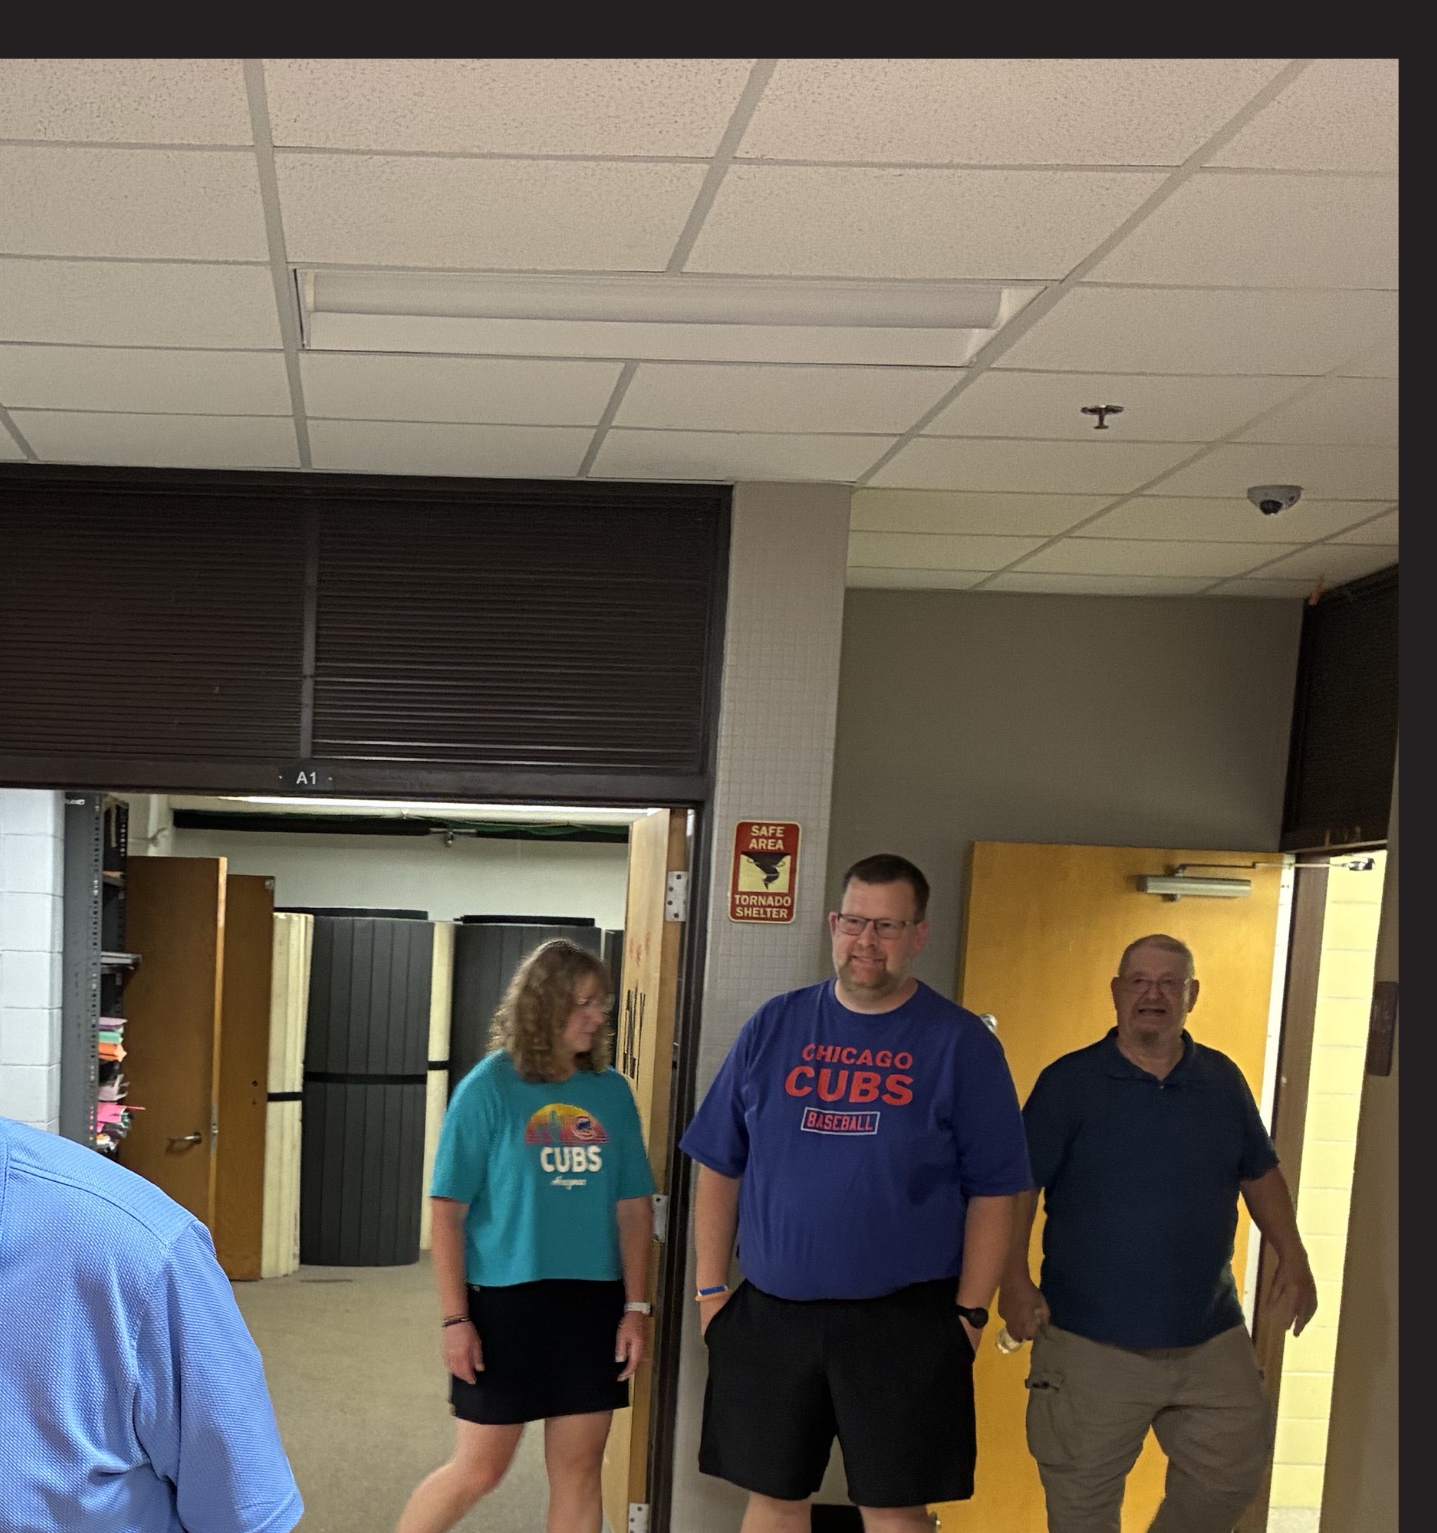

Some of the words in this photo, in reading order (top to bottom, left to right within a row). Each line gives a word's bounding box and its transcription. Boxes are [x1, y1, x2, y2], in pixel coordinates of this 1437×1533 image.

[296, 771, 316, 784] A1
[750, 825, 785, 837] SAFE
[749, 838, 784, 849] AREA
[734, 895, 791, 906] TORNADO
[735, 907, 788, 918] SHELTER
[802, 1042, 913, 1070] CHICAGO
[784, 1065, 914, 1106] CUBS
[807, 1111, 873, 1131] BASEBALL
[540, 1145, 603, 1173] CUBS
